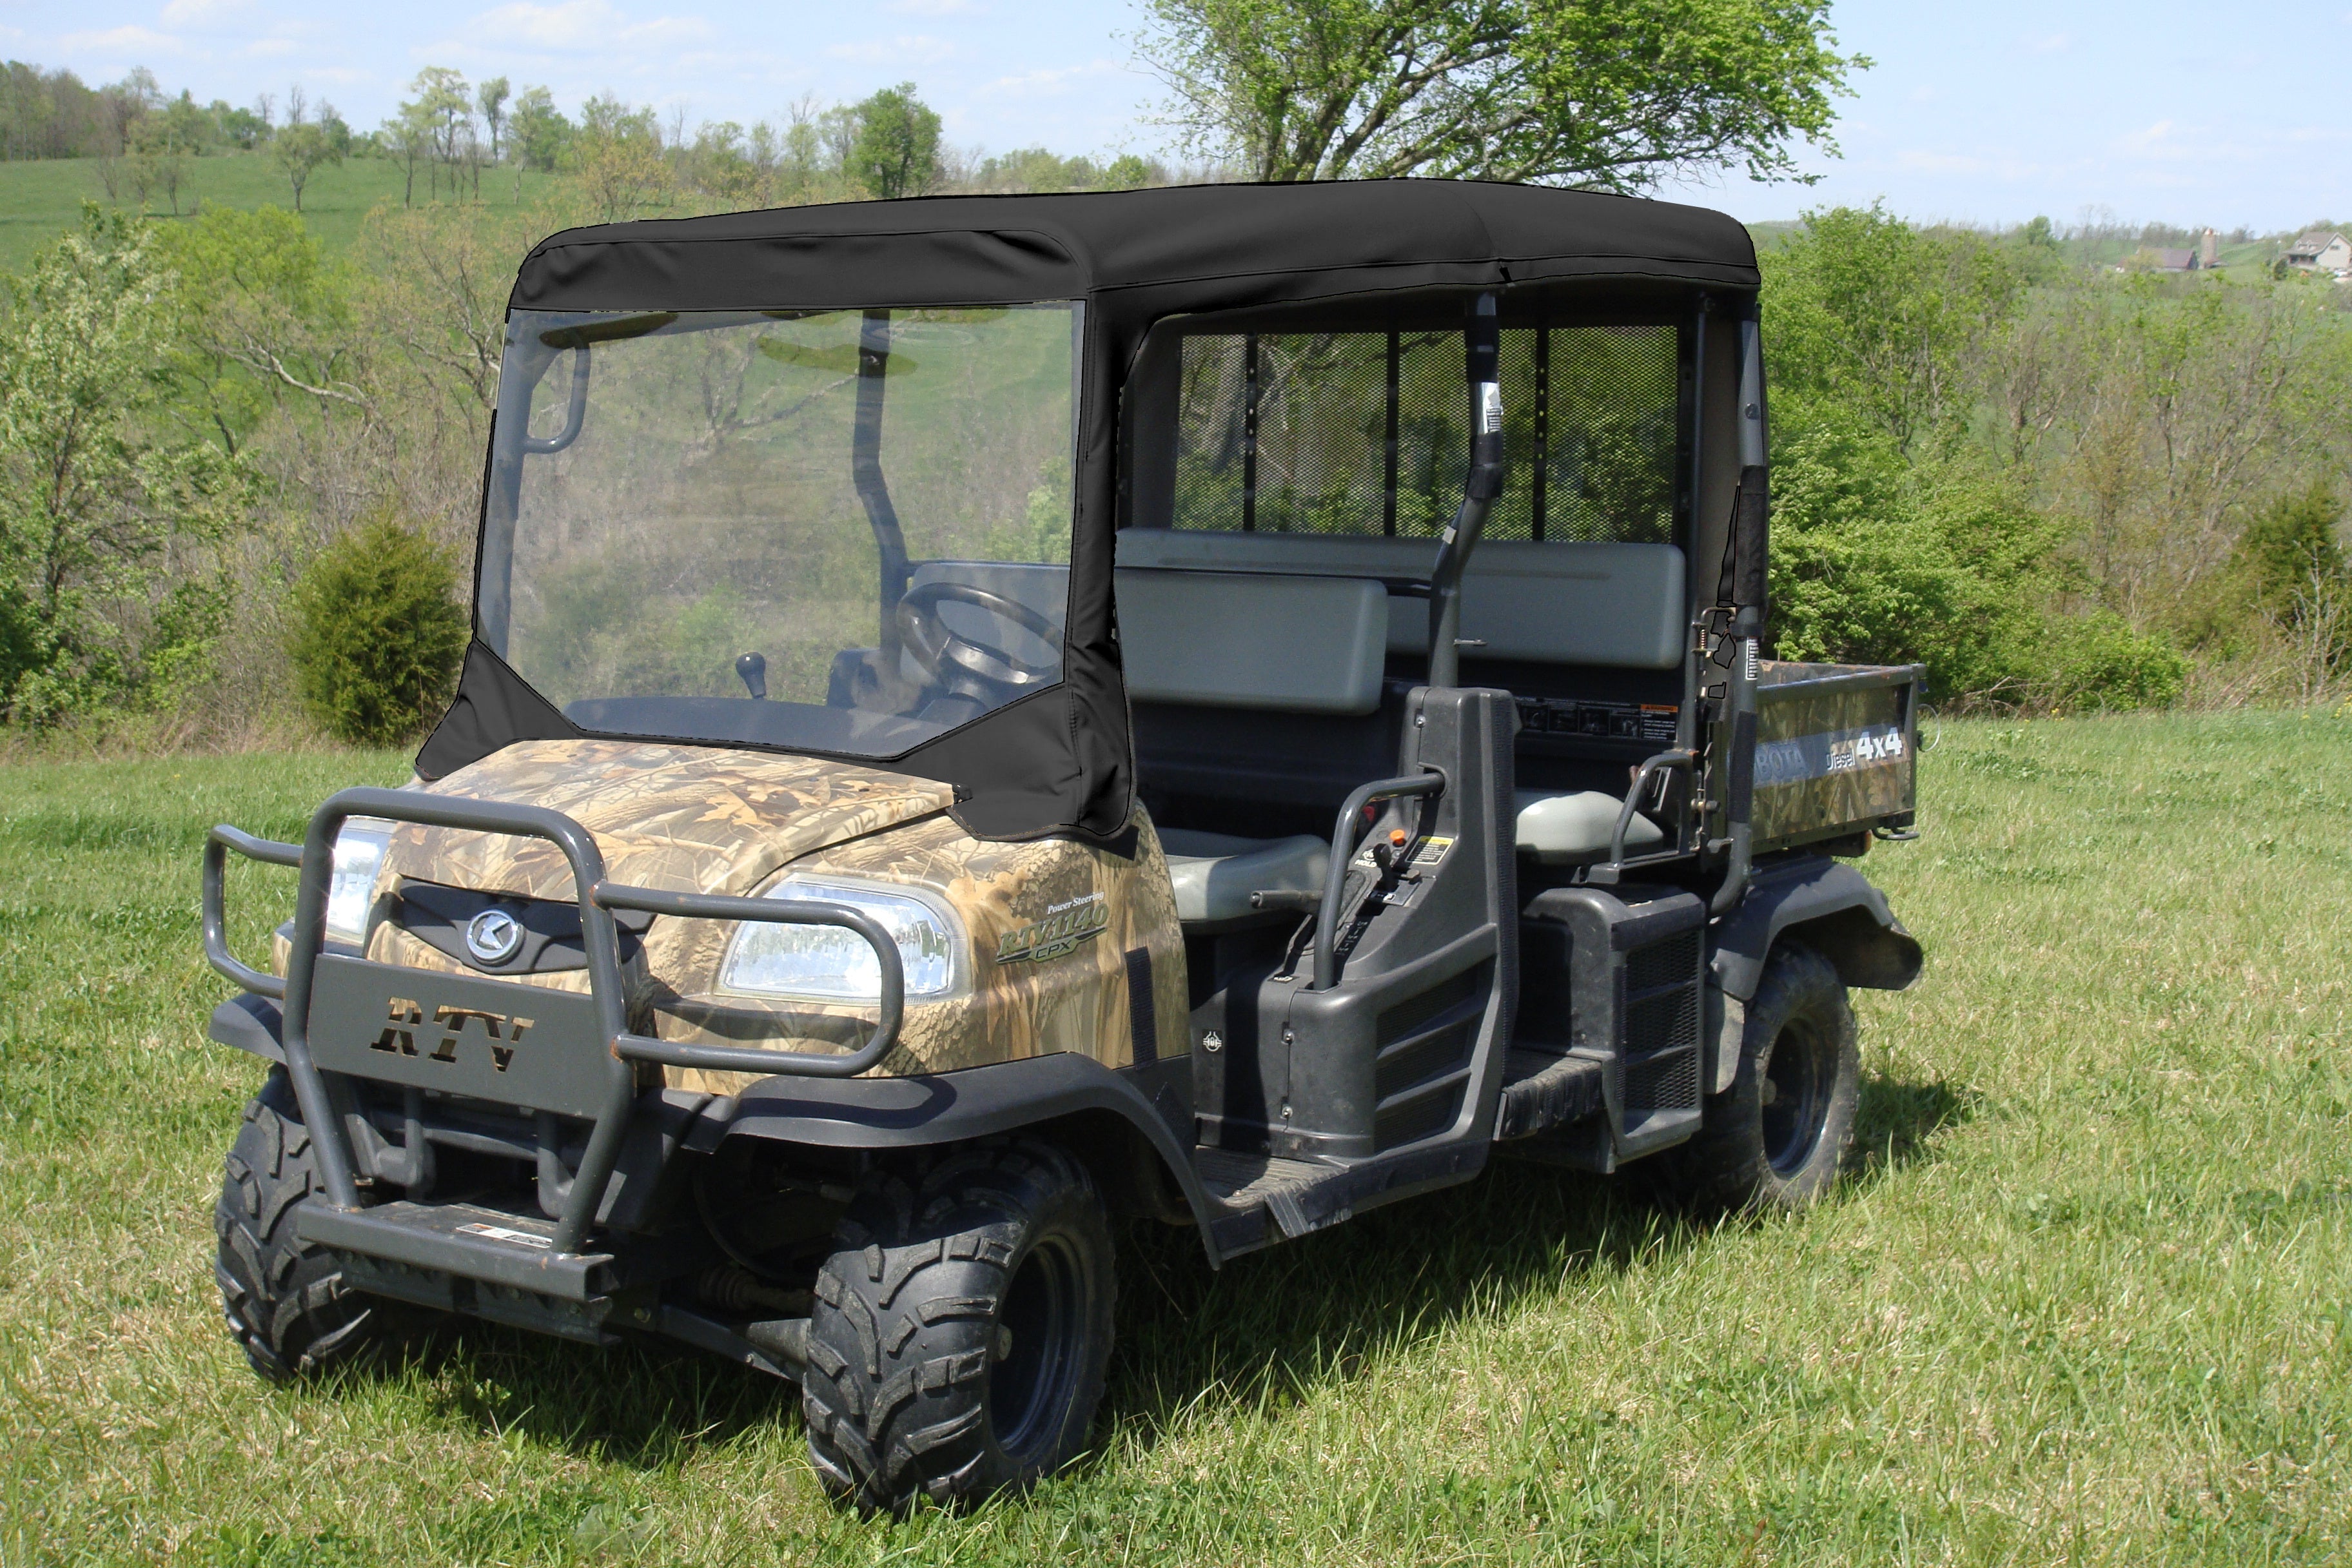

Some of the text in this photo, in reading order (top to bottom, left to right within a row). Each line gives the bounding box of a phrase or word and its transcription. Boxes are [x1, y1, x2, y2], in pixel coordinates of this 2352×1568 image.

[1753, 727, 1903, 779] BOTA Diesel 4x4
[1047, 892, 1104, 914] Power Steering
[997, 903, 1108, 957] RTV1140
[1036, 942, 1070, 958] CPX
[369, 997, 534, 1072] RTV
